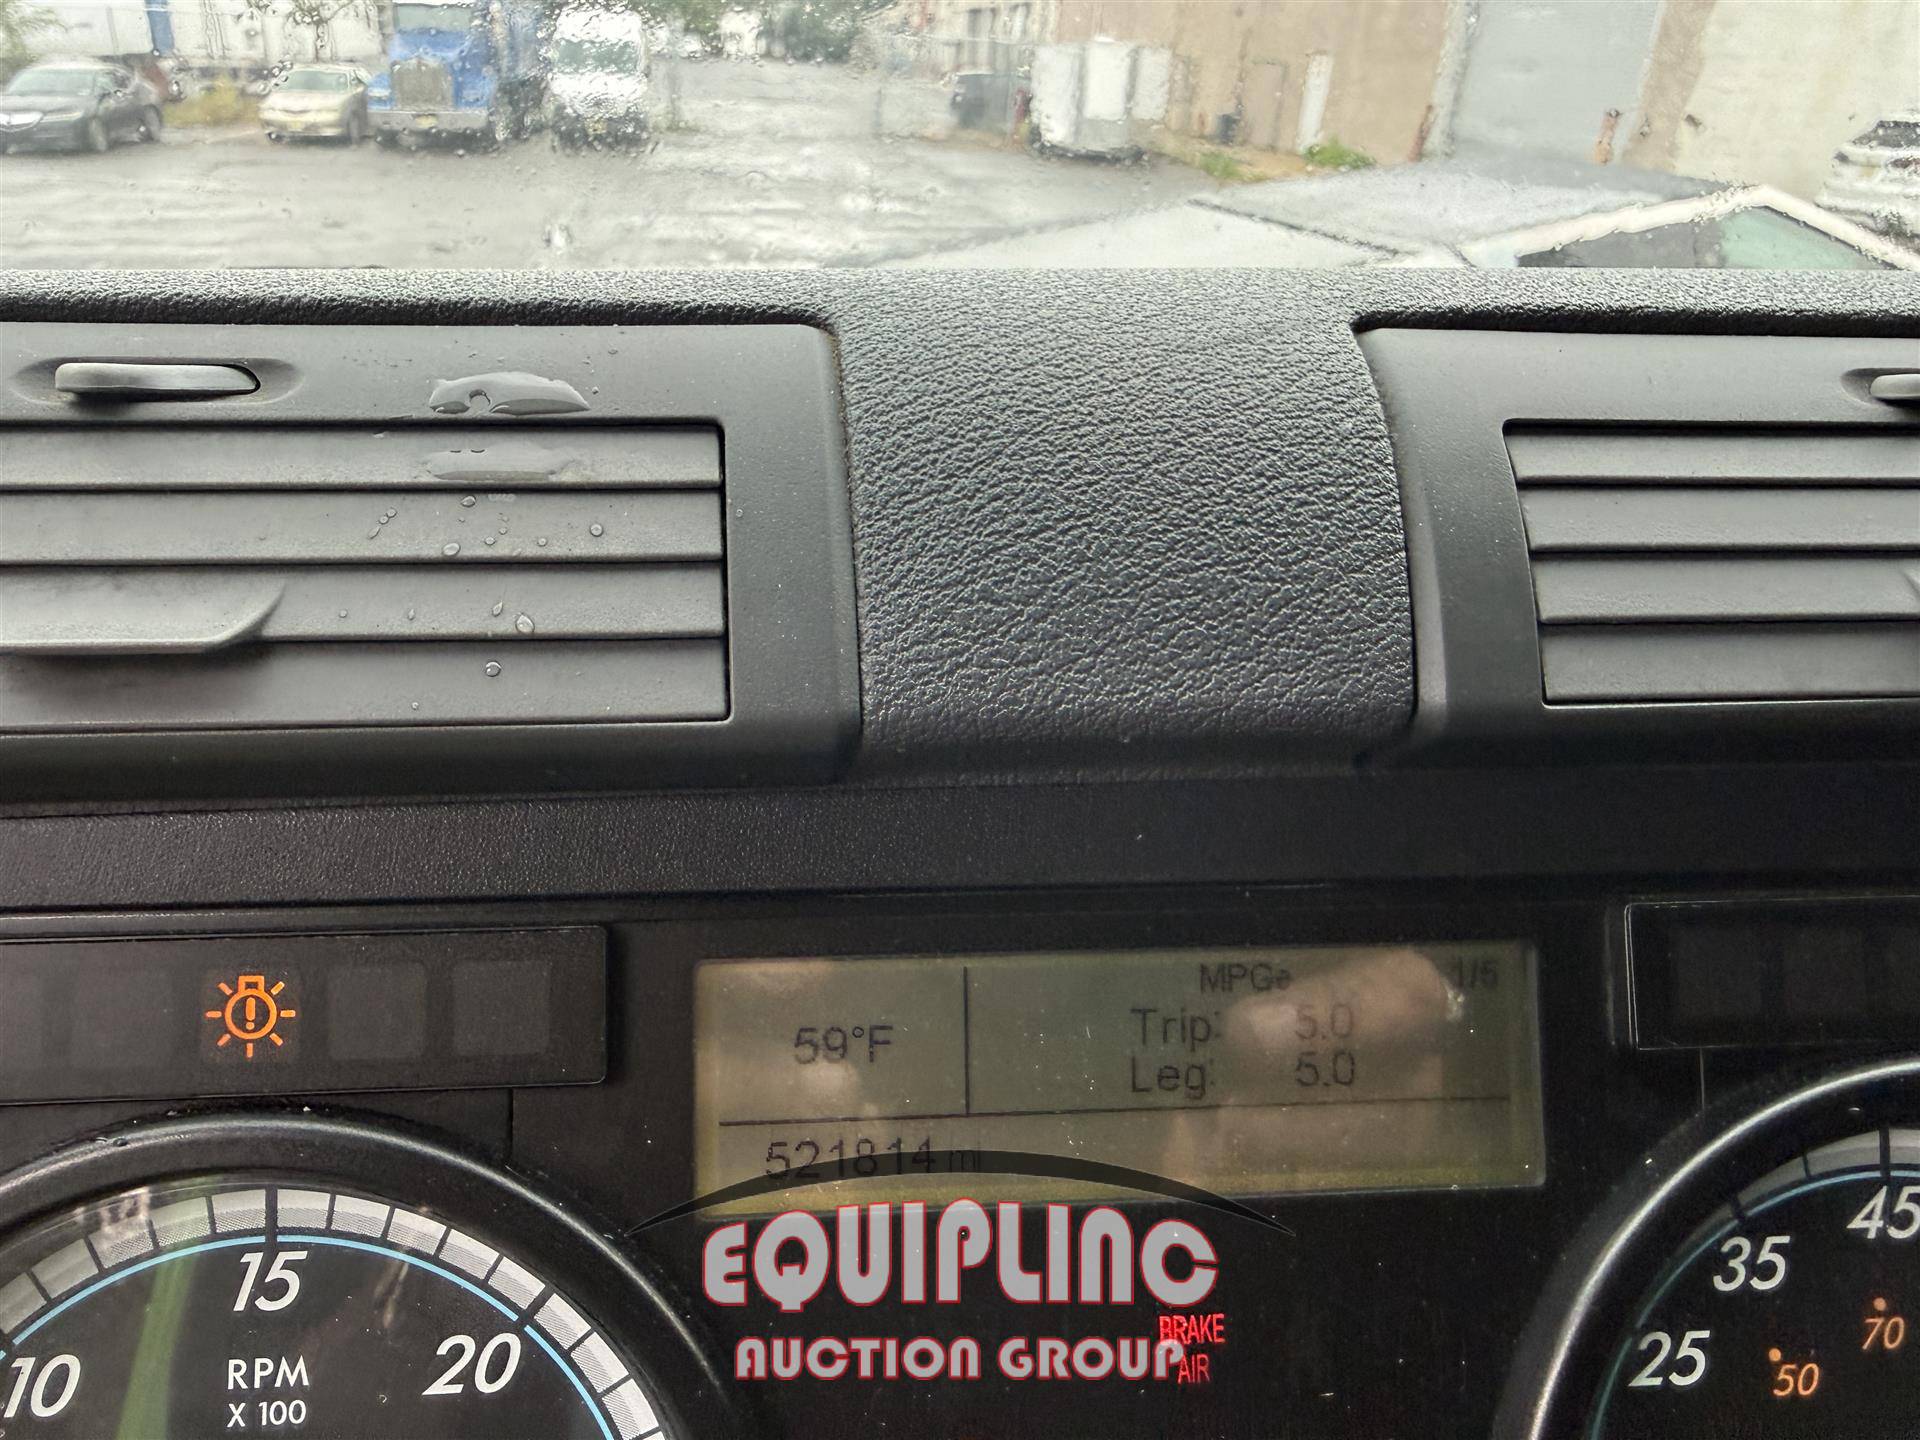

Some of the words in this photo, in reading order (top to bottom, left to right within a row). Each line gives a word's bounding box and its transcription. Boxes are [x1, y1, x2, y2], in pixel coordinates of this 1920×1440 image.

[1295, 1002, 1354, 1040] 5.0
[793, 1025, 893, 1065] 59°F
[1295, 1048, 1356, 1086] 5.0
[764, 1137, 936, 1178] 521814
[1846, 1185, 1920, 1239] 45
[233, 1250, 307, 1312] 15
[1713, 1235, 1791, 1292] 35
[1158, 1313, 1226, 1346] BRAKE
[1862, 1317, 1905, 1350] 70
[227, 1355, 310, 1390] RPM
[421, 1333, 521, 1397] 20
[1177, 1353, 1211, 1384] AIR
[1628, 1330, 1711, 1387] 25
[3, 1354, 82, 1419] 10
[1773, 1363, 1820, 1397] 50
[227, 1403, 246, 1428] X
[258, 1400, 307, 1426] 100
